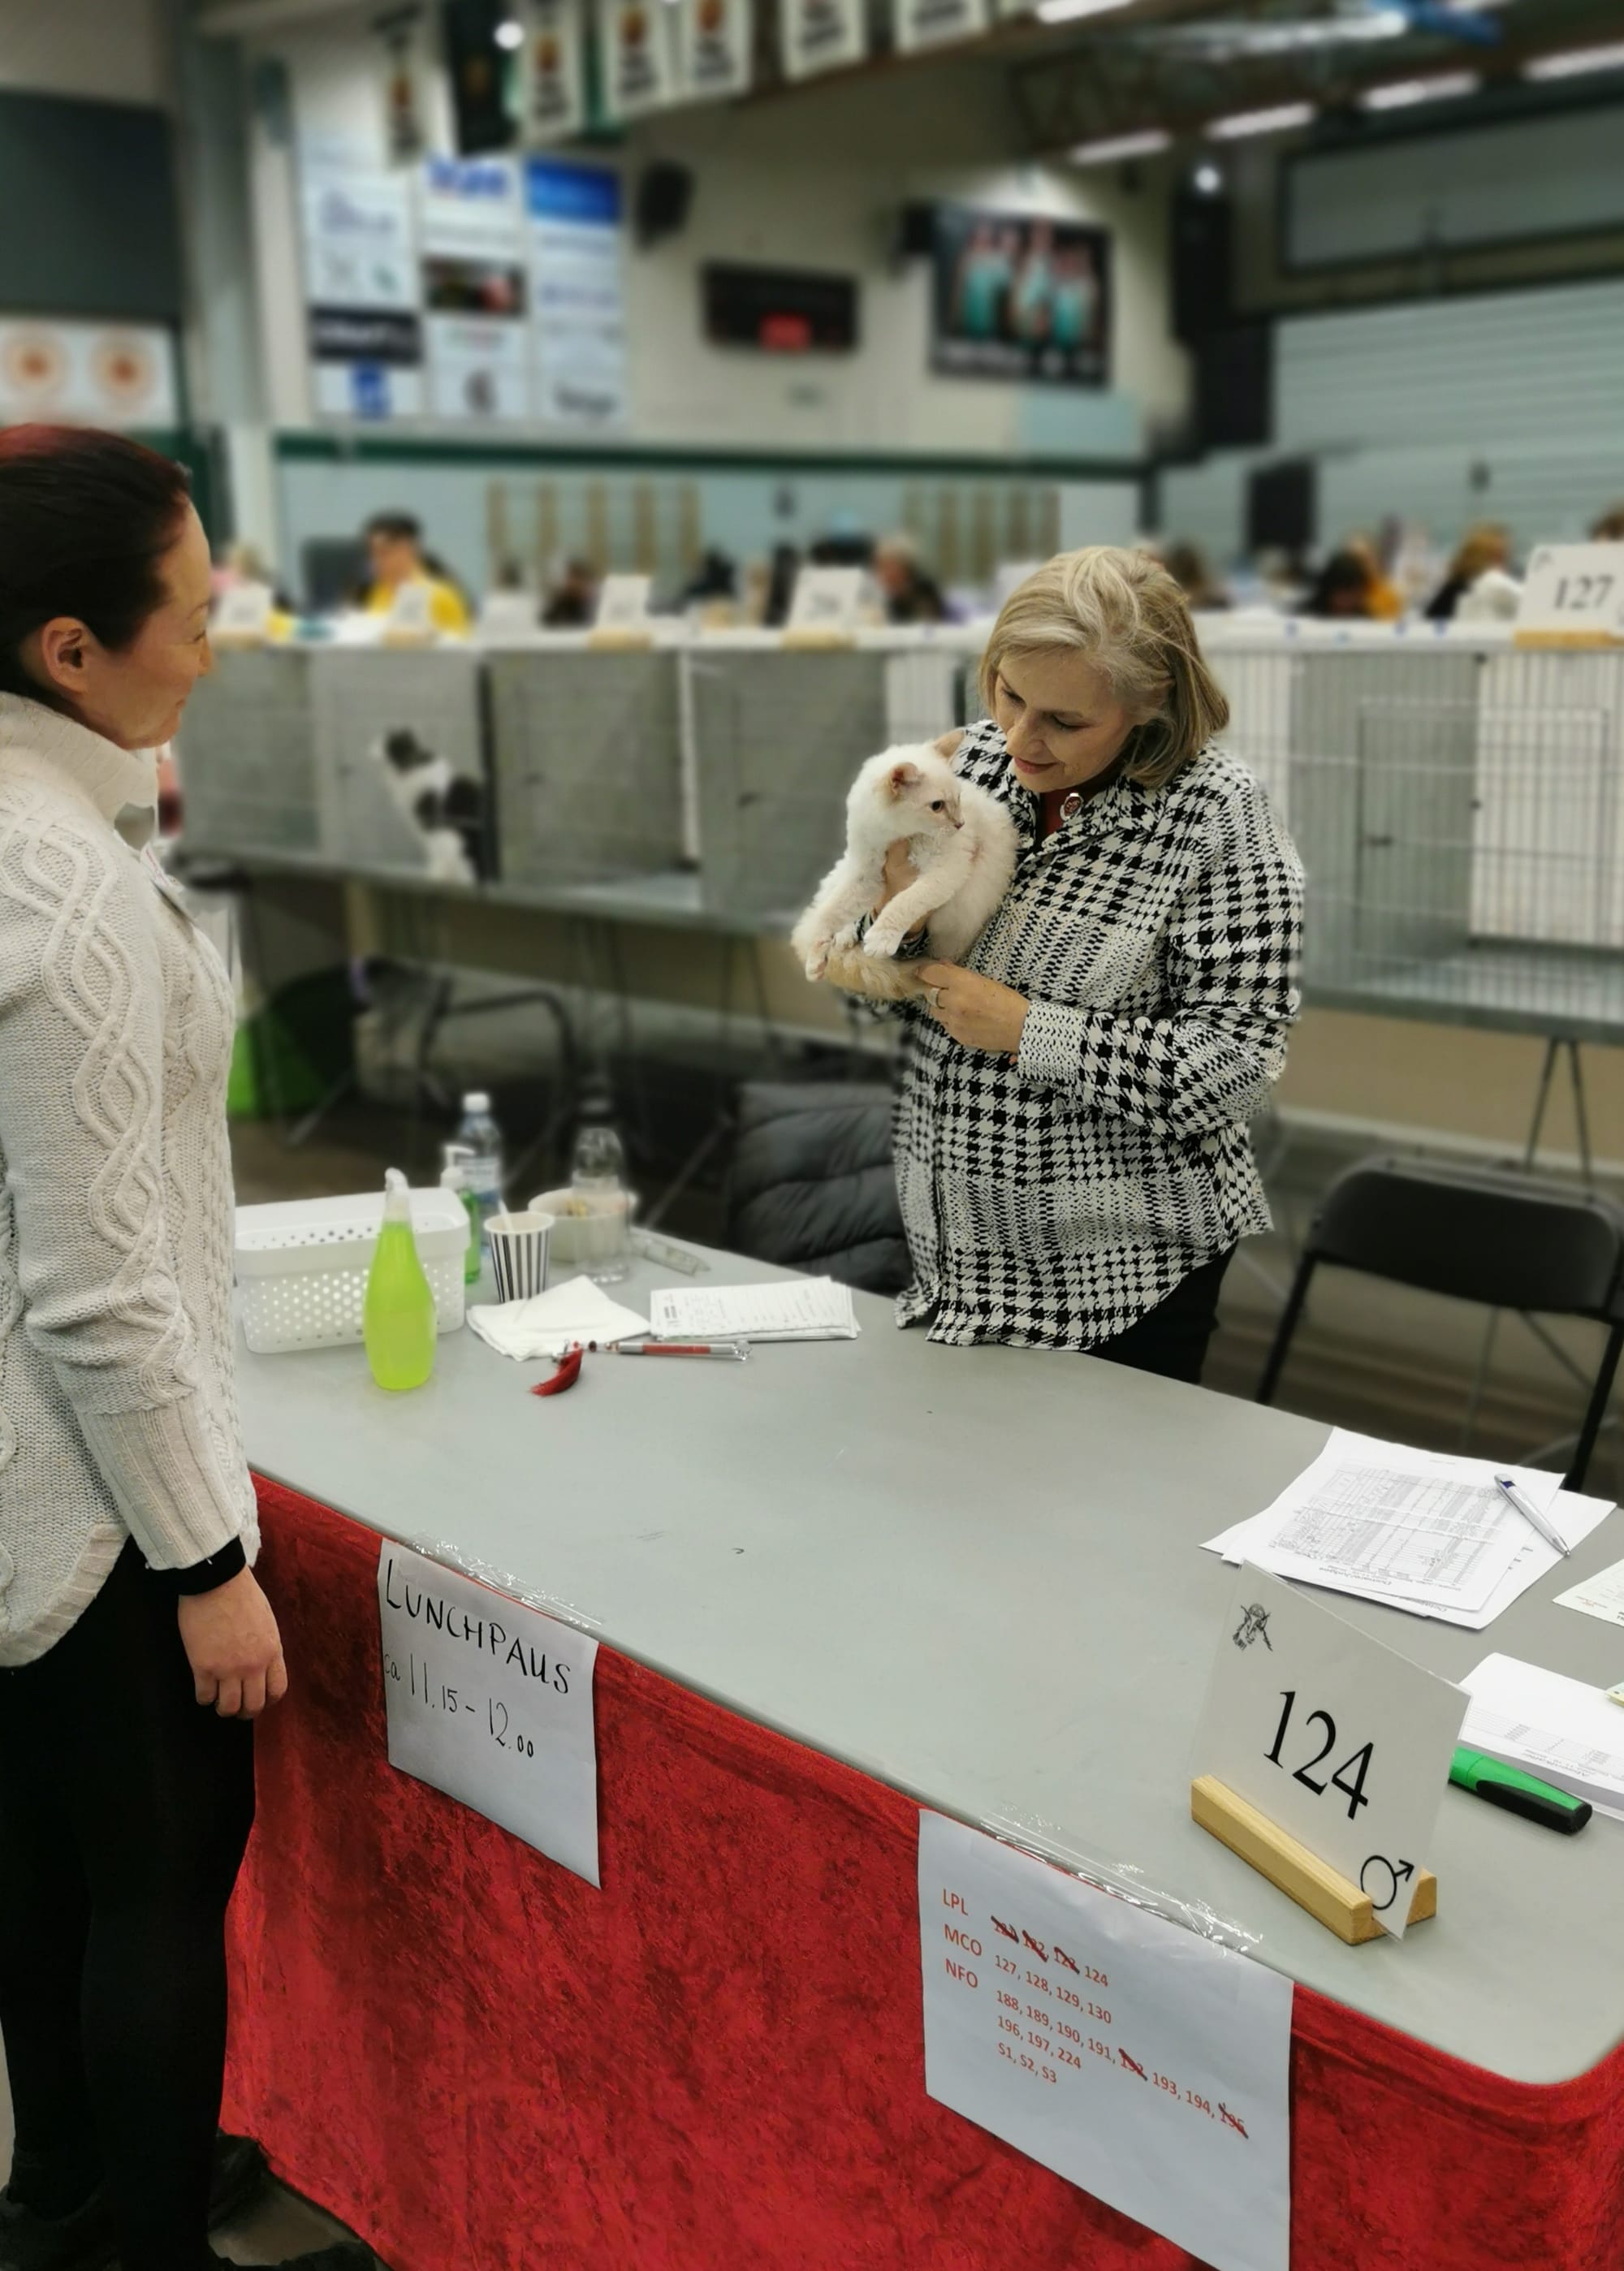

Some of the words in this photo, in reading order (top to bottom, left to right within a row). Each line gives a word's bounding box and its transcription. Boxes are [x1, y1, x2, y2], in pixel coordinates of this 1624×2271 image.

[1553, 573, 1615, 611] 127
[383, 1653, 401, 1682] ca
[386, 1558, 571, 1695] LUNCHPAUS
[1263, 1690, 1376, 1820] 124
[942, 1888, 969, 1916] LPL
[1084, 1965, 1109, 1988] 124
[944, 1923, 983, 1957] MCO
[995, 1954, 1021, 1981] 127,
[1026, 1971, 1052, 1997] 128,
[1056, 1986, 1085, 2013] 129,
[1086, 2001, 1112, 2025] 130
[944, 1958, 979, 1988] NFO
[996, 1989, 1023, 2016] 188,
[1026, 2005, 1054, 2031] 189,
[1056, 2020, 1085, 2048] 190,
[1086, 2036, 1116, 2064] 191,
[1152, 2071, 1181, 2100] 193,
[1186, 2090, 1216, 2118] 194,
[996, 2015, 1025, 2043] 196,
[1027, 2030, 1054, 2058] 197,
[1057, 2048, 1082, 2070] 224
[997, 2042, 1017, 2065] S1,
[1020, 2053, 1040, 2076] S2,
[1041, 2066, 1058, 2084] S3
